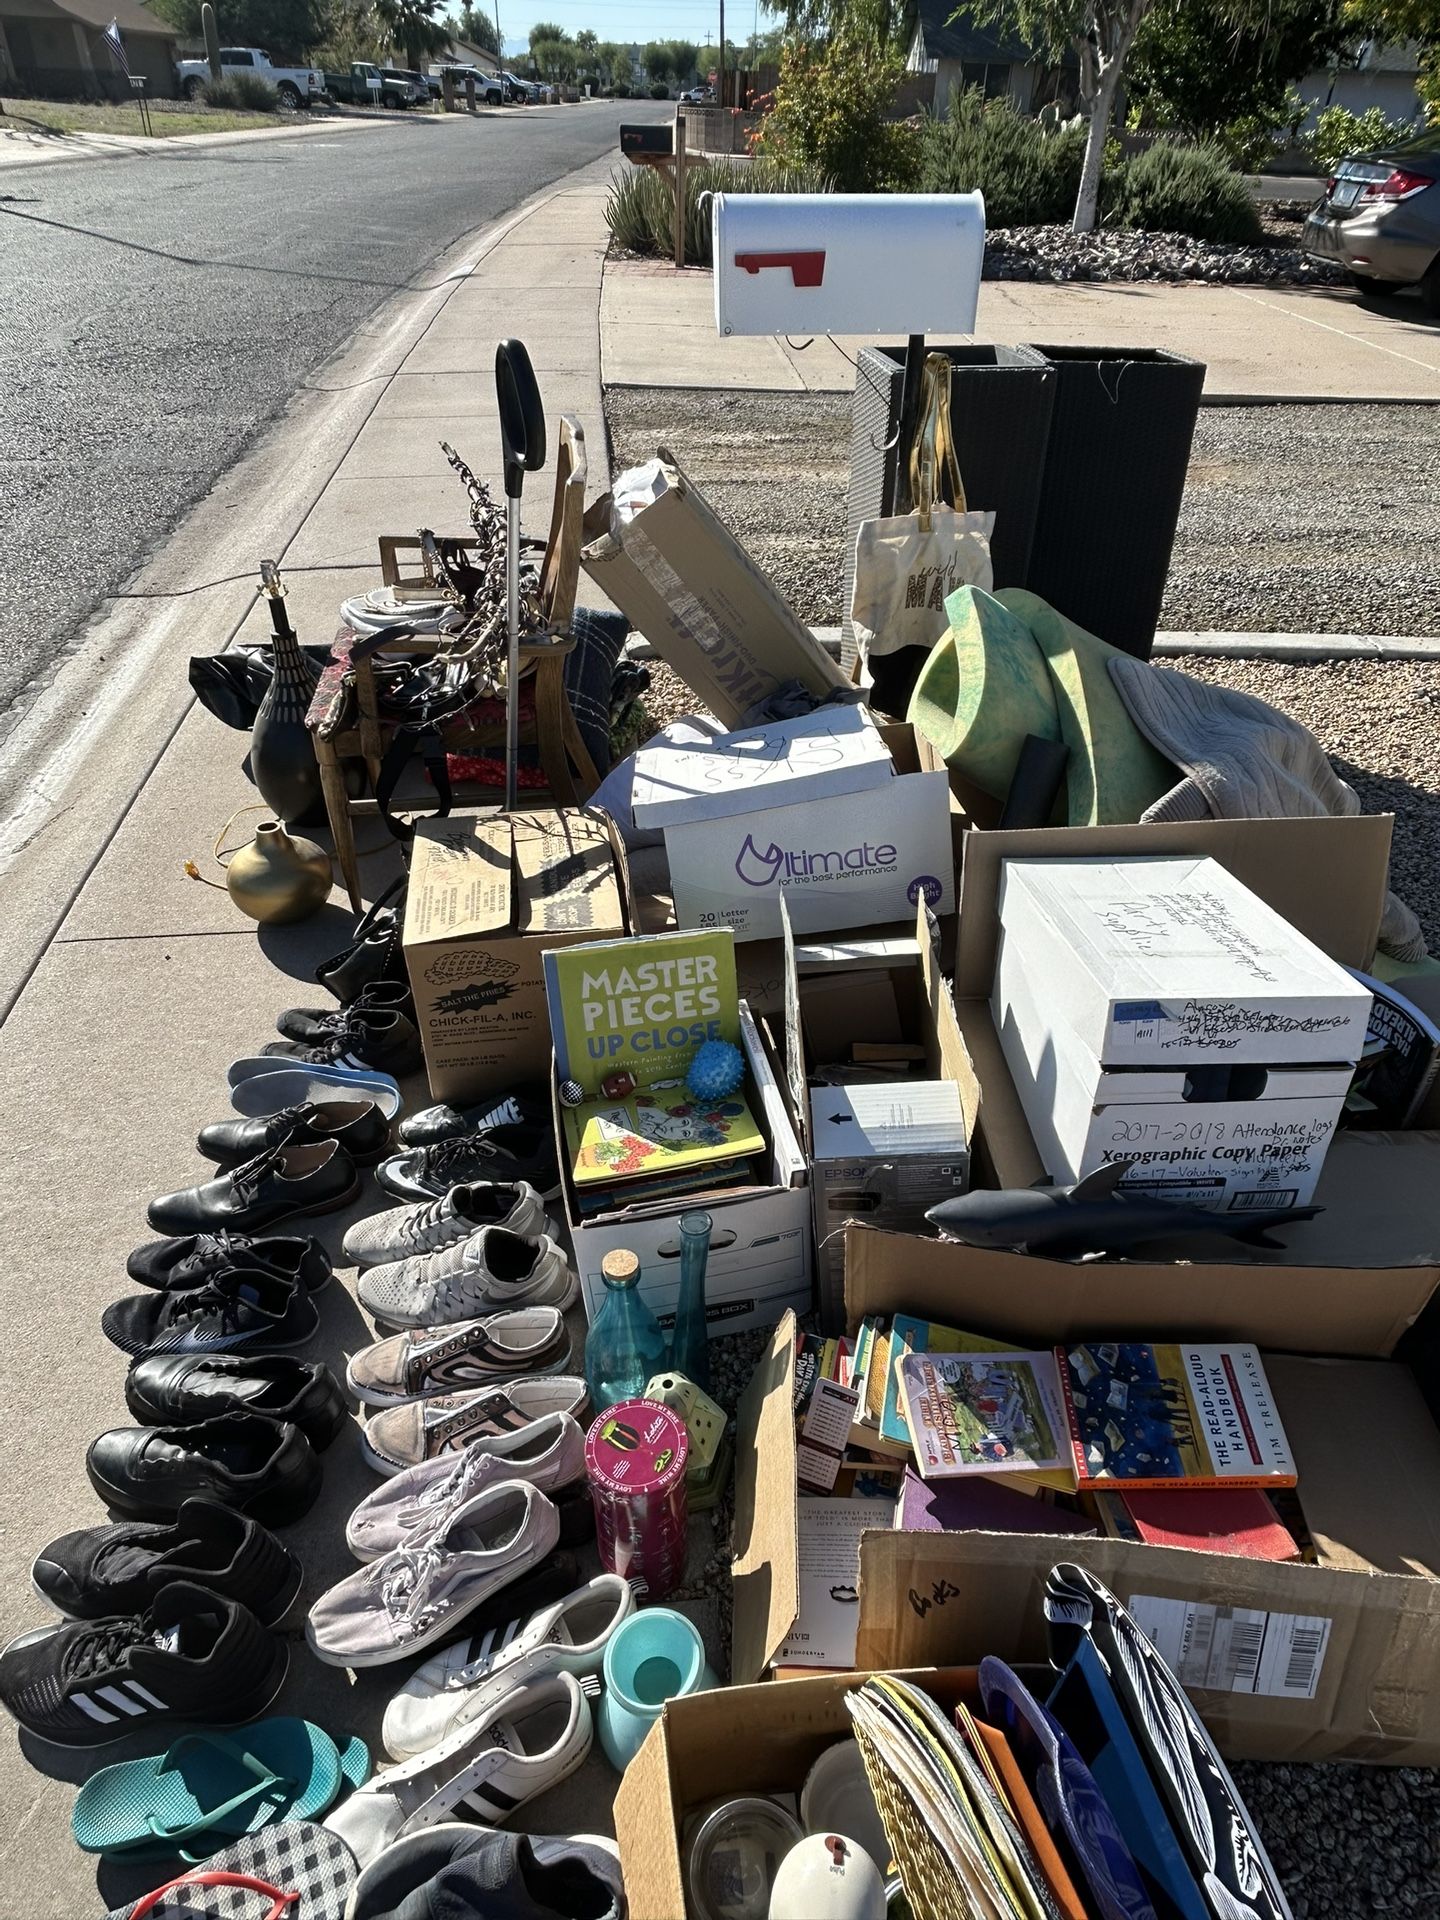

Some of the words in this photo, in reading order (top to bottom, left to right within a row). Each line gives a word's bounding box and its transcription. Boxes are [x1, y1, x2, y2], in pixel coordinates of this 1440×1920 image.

[918, 550, 958, 580] wild
[735, 834, 898, 887] Ultimate
[778, 877, 793, 887] for
[794, 875, 810, 884] the
[836, 865, 898, 881] performance
[699, 912, 715, 922] 20
[721, 909, 749, 918] Letter
[727, 917, 745, 925] size
[582, 955, 719, 999] MASTER
[441, 997, 462, 1008] SALT
[463, 993, 480, 1002] THE
[583, 985, 721, 1032] PIECES
[429, 1013, 508, 1028] CHICK-FIL-A,
[511, 1010, 536, 1020] INC.
[587, 1034, 624, 1060] UP
[1391, 1033, 1412, 1057] HAS
[478, 1096, 524, 1130] NIKE
[1112, 1120, 1226, 1144] 2017-2018
[1232, 1122, 1306, 1139] Attendance
[1101, 1145, 1207, 1165] Xerographic
[1212, 1146, 1254, 1162] Copy
[1261, 1143, 1311, 1161] Paper
[721, 1303, 748, 1314] BOX
[1190, 1354, 1223, 1436] READ-ALOUD
[1242, 1352, 1274, 1429] TRELEASE
[1210, 1367, 1245, 1451] HANDBOOK
[1214, 1440, 1231, 1467] THE
[1270, 1438, 1287, 1464] JIM
